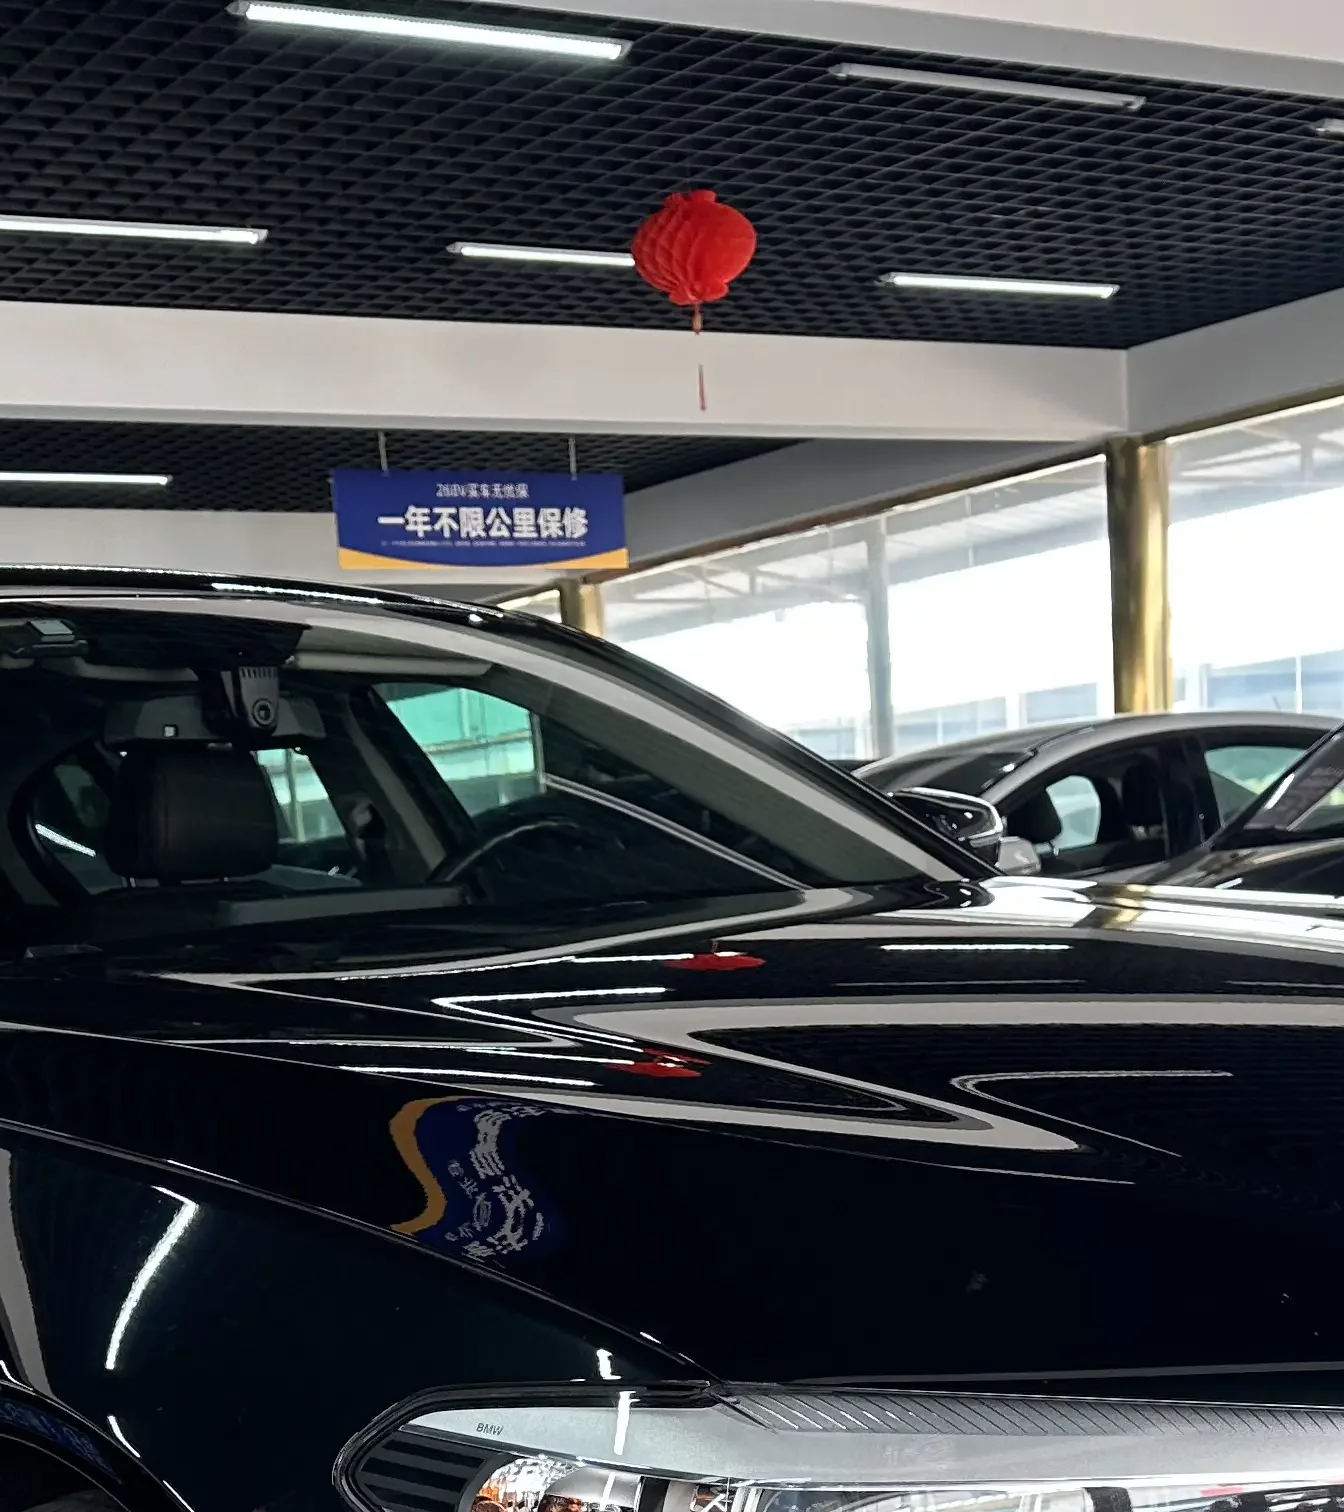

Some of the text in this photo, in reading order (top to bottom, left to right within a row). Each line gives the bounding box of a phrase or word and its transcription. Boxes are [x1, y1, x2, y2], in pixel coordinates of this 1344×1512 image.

[377, 505, 588, 539] 一年不限公里保修
[476, 1422, 504, 1435] BMW
